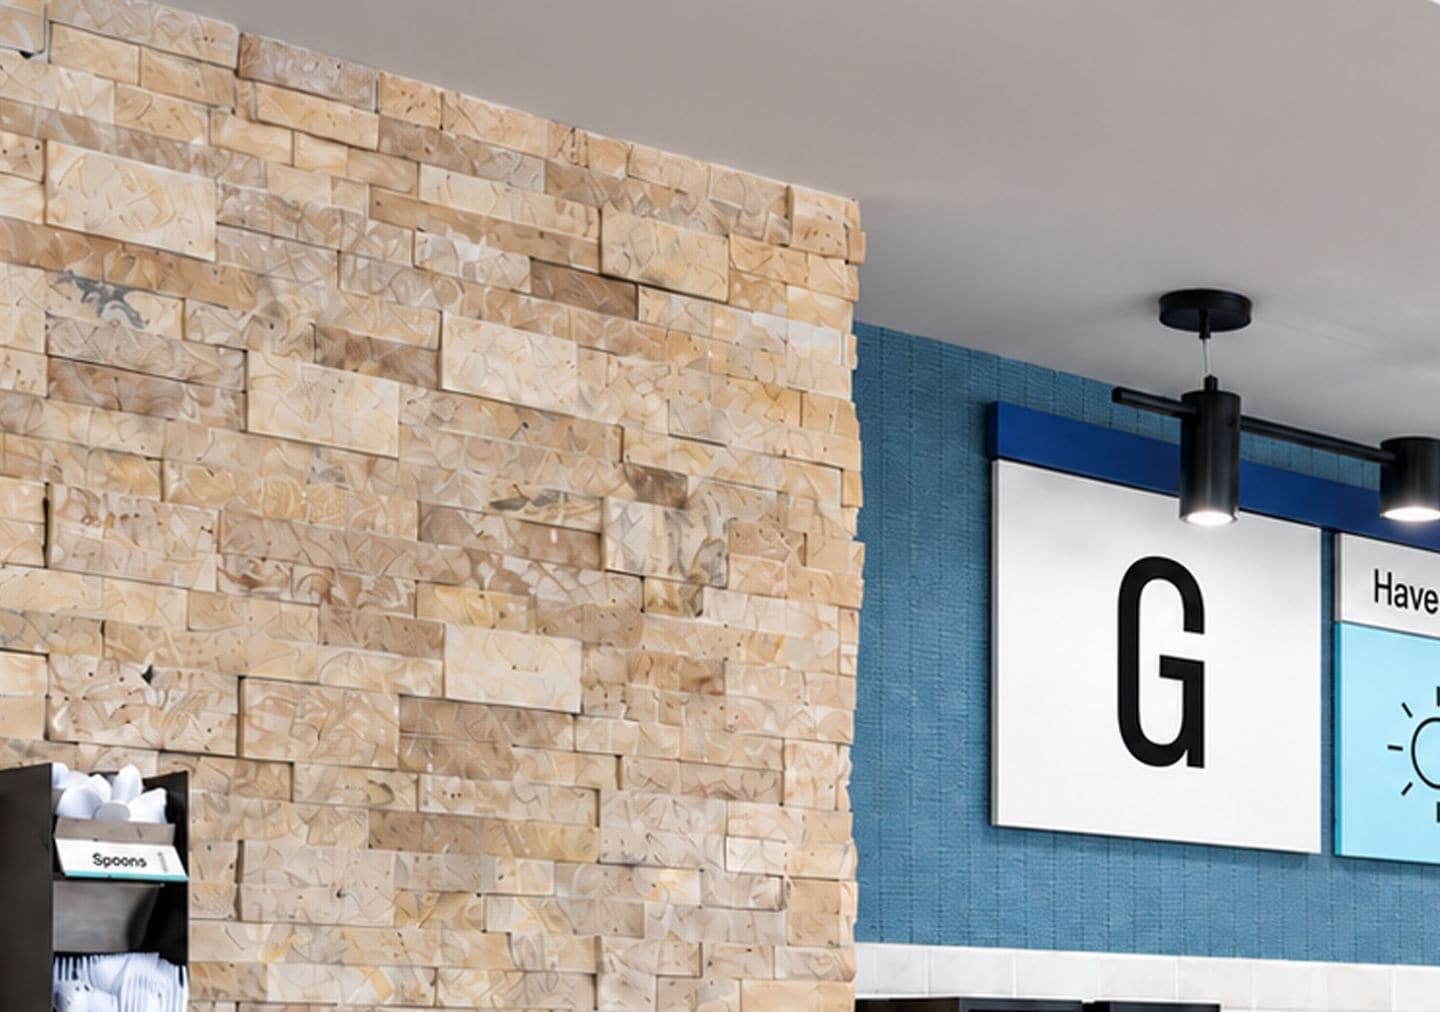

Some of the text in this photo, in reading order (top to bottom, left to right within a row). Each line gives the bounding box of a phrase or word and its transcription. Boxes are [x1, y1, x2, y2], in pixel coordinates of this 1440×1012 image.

[1373, 567, 1439, 615] Have
[1117, 555, 1206, 769] G
[92, 852, 148, 869] Spoons
